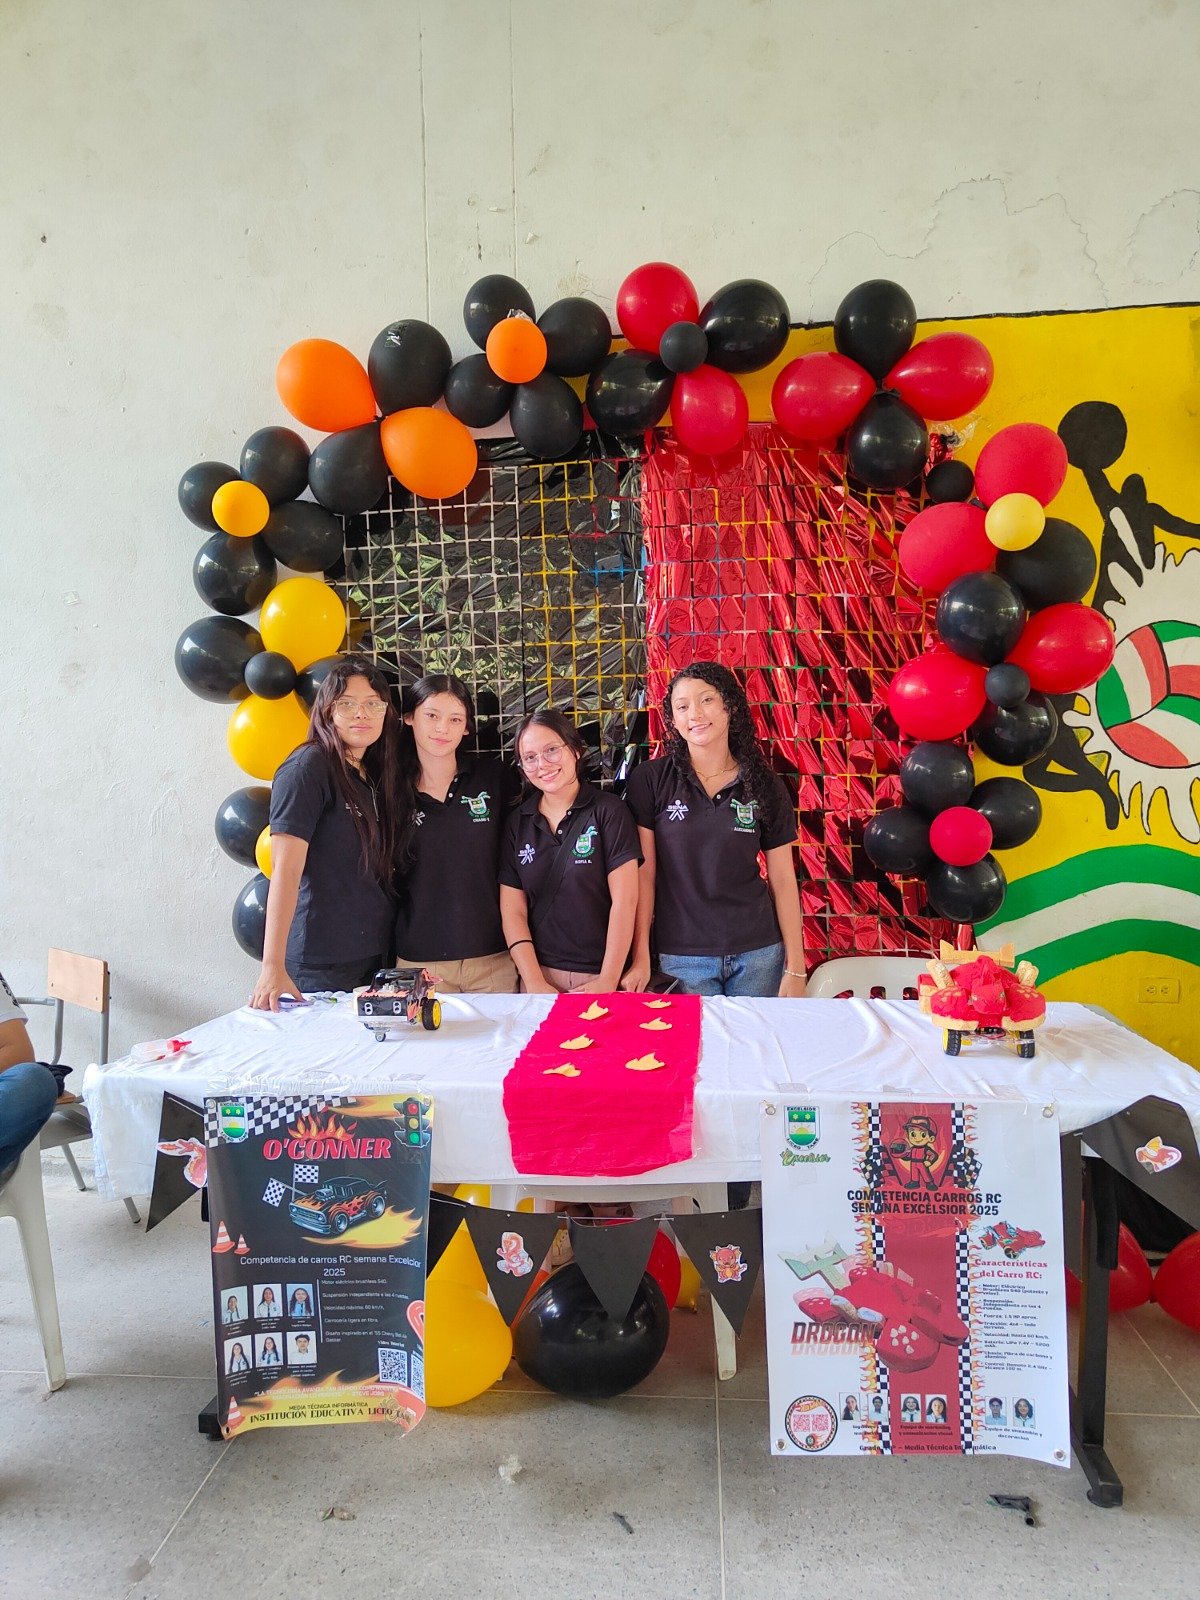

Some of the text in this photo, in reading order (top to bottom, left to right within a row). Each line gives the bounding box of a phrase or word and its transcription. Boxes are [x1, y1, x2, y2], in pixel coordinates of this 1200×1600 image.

[263, 1138, 391, 1160] O'CONNER
[847, 1190, 1002, 1204] COMPETENCIA CARROS RC
[851, 1202, 900, 1214] SEMANA
[969, 1205, 999, 1216] 2025
[240, 1256, 296, 1266] Competencia
[339, 1255, 352, 1263] RC
[388, 1255, 421, 1268] Excelcior
[975, 1259, 1048, 1268] Características
[323, 1268, 346, 1276] 2025
[997, 1270, 1024, 1279] Carro
[1026, 1271, 1042, 1279] RC:
[332, 1401, 368, 1409] INFORMÁTICA
[311, 1408, 363, 1418] EDUCATIVA
[368, 1407, 392, 1416] LICEO
